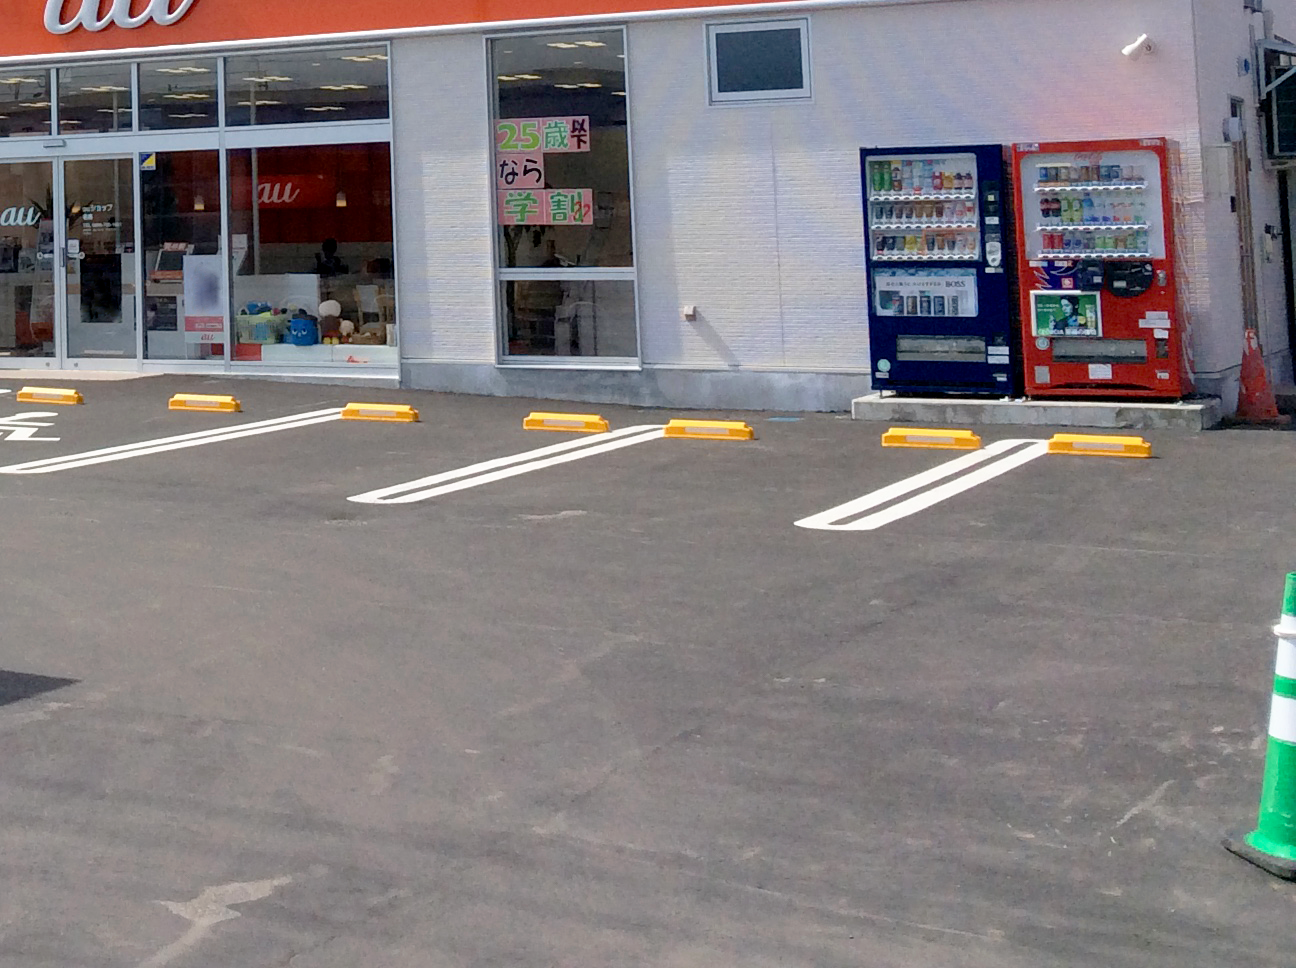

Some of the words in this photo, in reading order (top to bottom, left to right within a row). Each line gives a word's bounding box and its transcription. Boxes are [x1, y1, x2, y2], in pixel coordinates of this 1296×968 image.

[499, 158, 542, 185] なら
[257, 182, 301, 204] au
[0, 206, 42, 226] au
